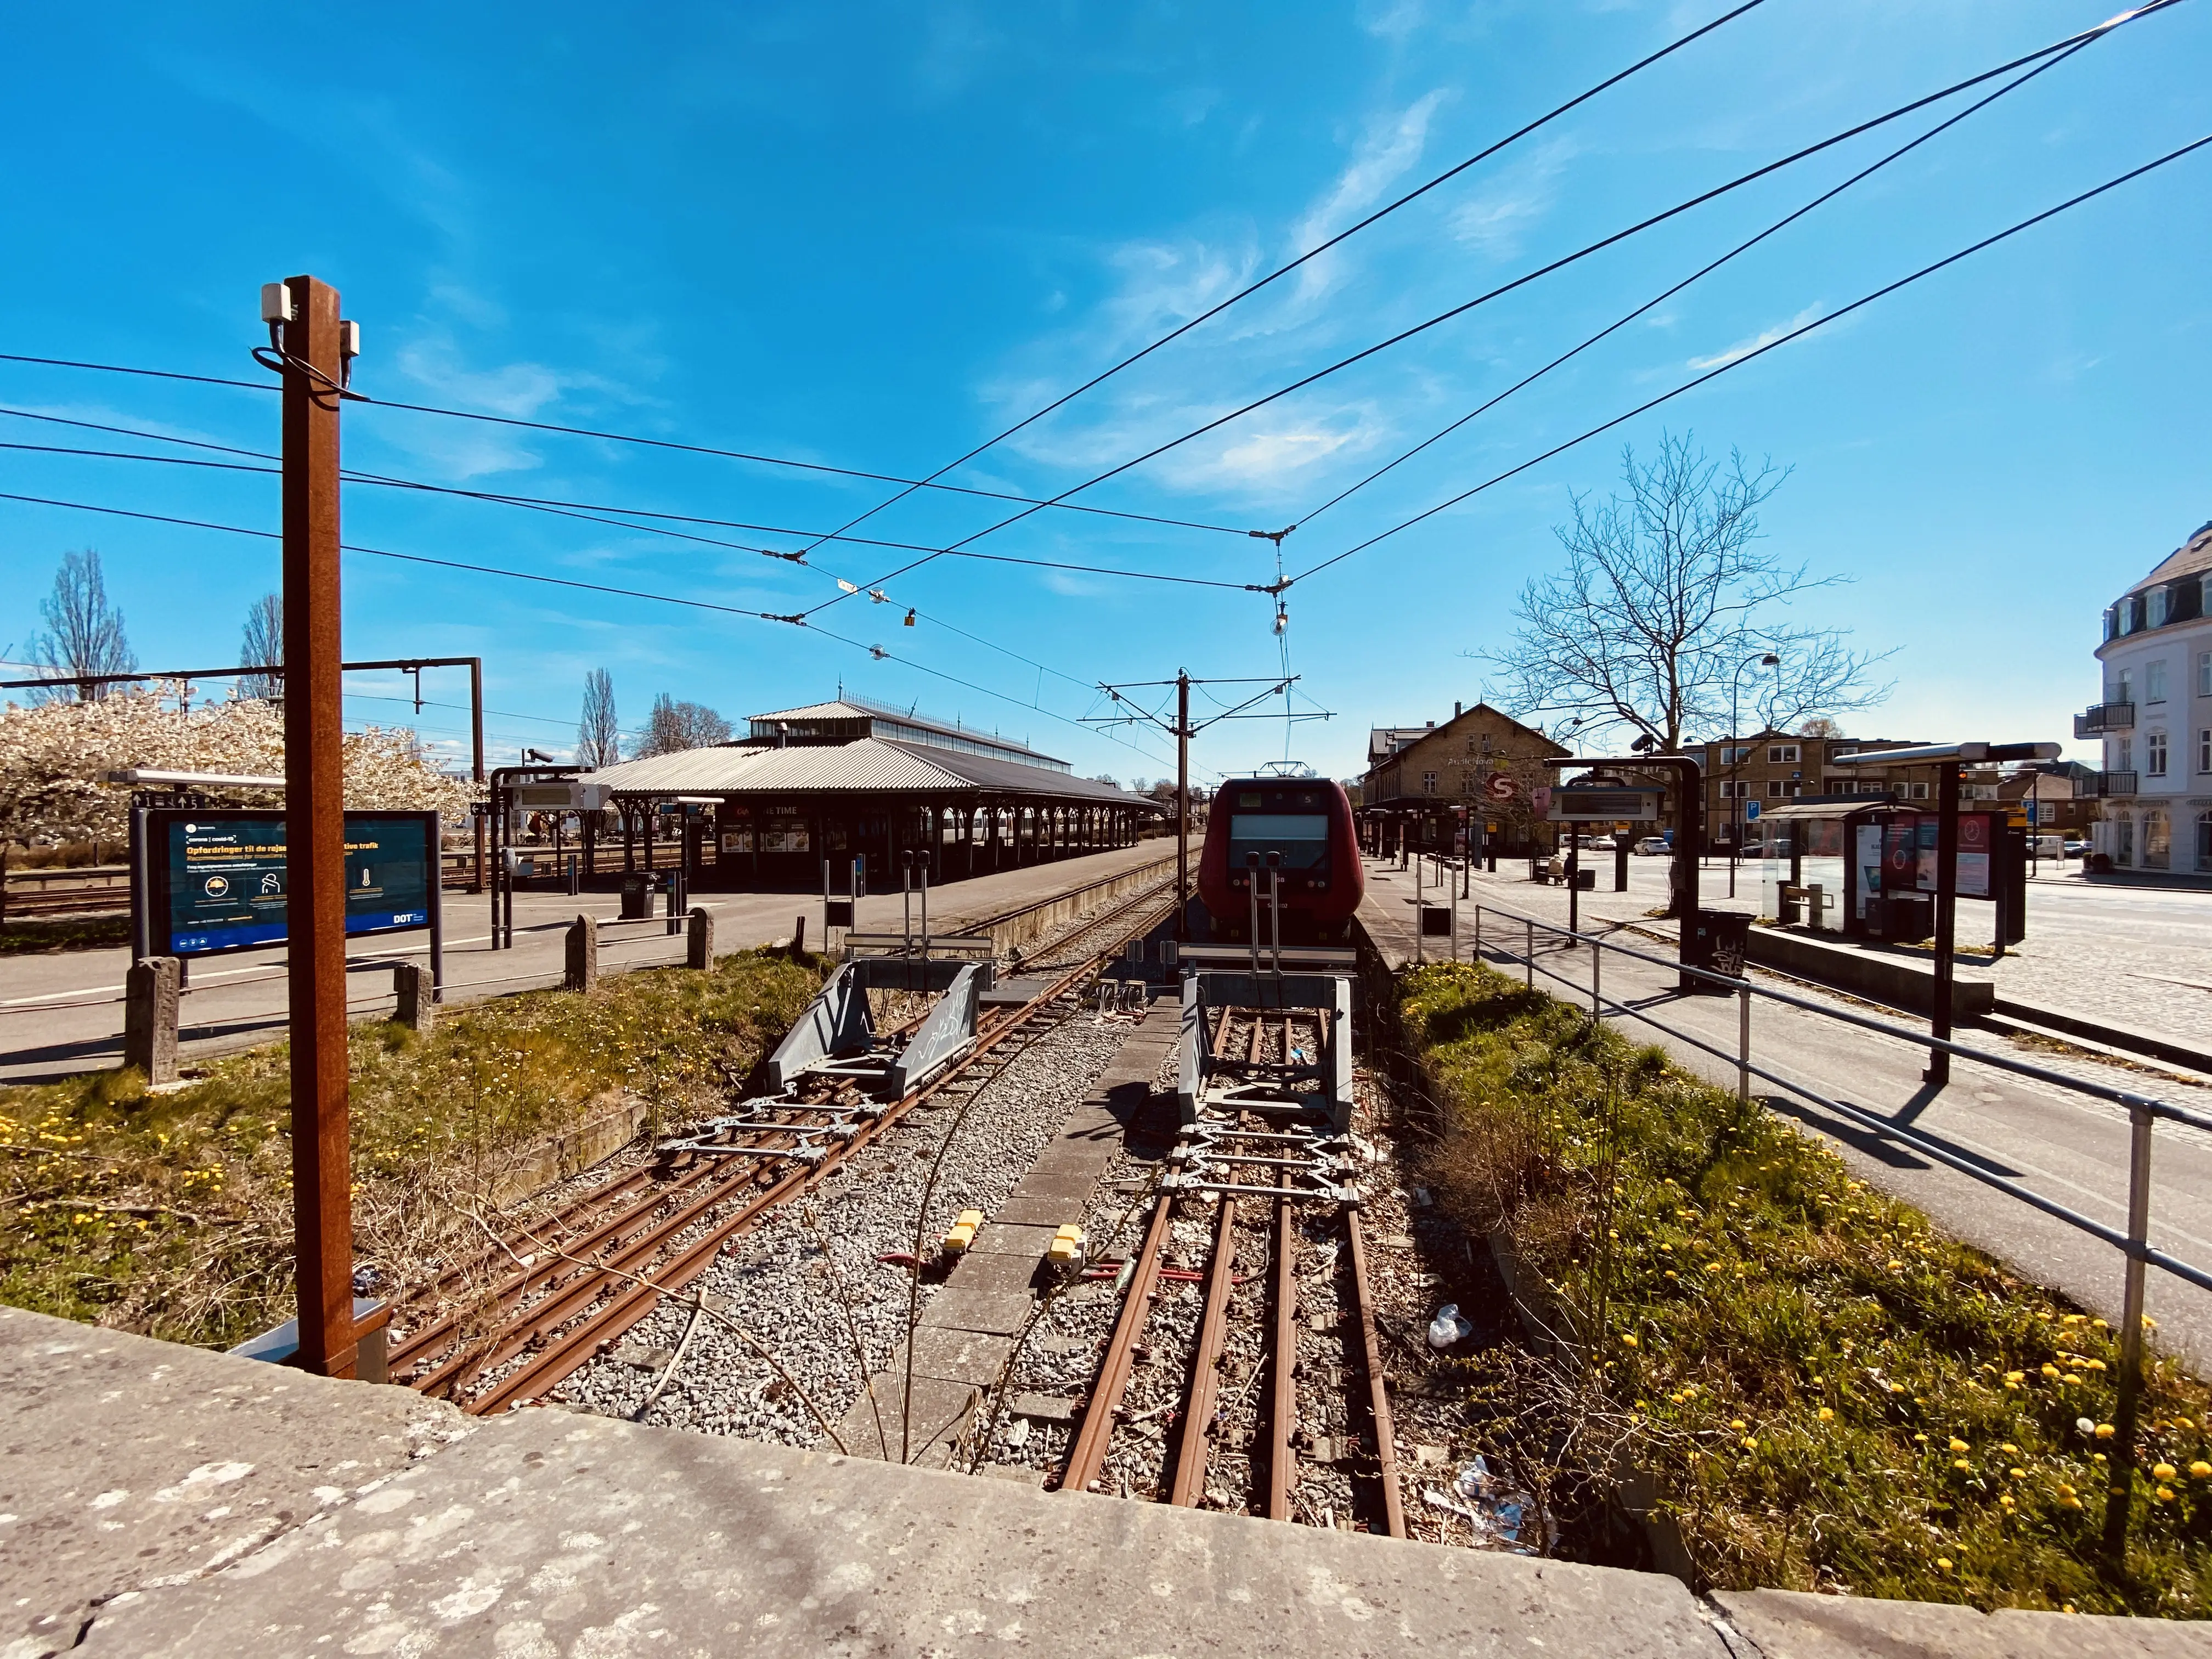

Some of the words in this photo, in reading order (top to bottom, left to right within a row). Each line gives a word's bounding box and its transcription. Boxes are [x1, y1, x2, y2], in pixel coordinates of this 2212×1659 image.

[1494, 778, 1513, 798] S
[187, 845, 243, 855] Opfordringer
[394, 913, 413, 923] DOT
